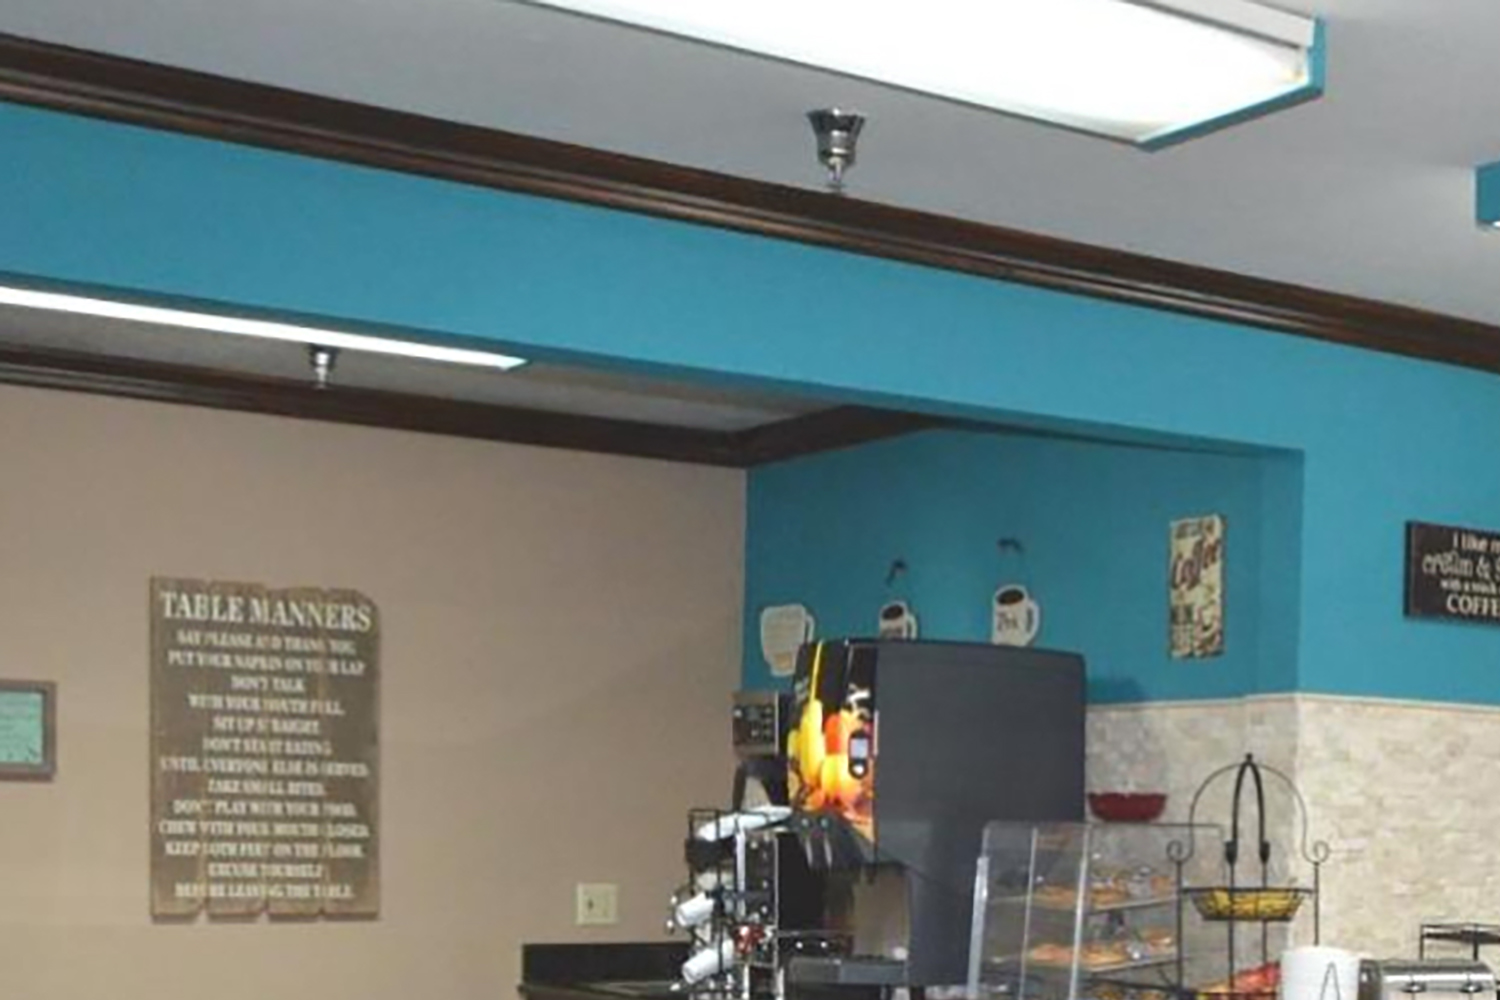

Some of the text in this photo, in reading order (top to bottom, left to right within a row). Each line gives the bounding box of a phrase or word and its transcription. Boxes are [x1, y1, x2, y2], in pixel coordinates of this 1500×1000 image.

[1452, 531, 1459, 548] I
[1461, 533, 1488, 551] like
[1476, 556, 1491, 579] &
[160, 590, 373, 633] TABLE MANNERS
